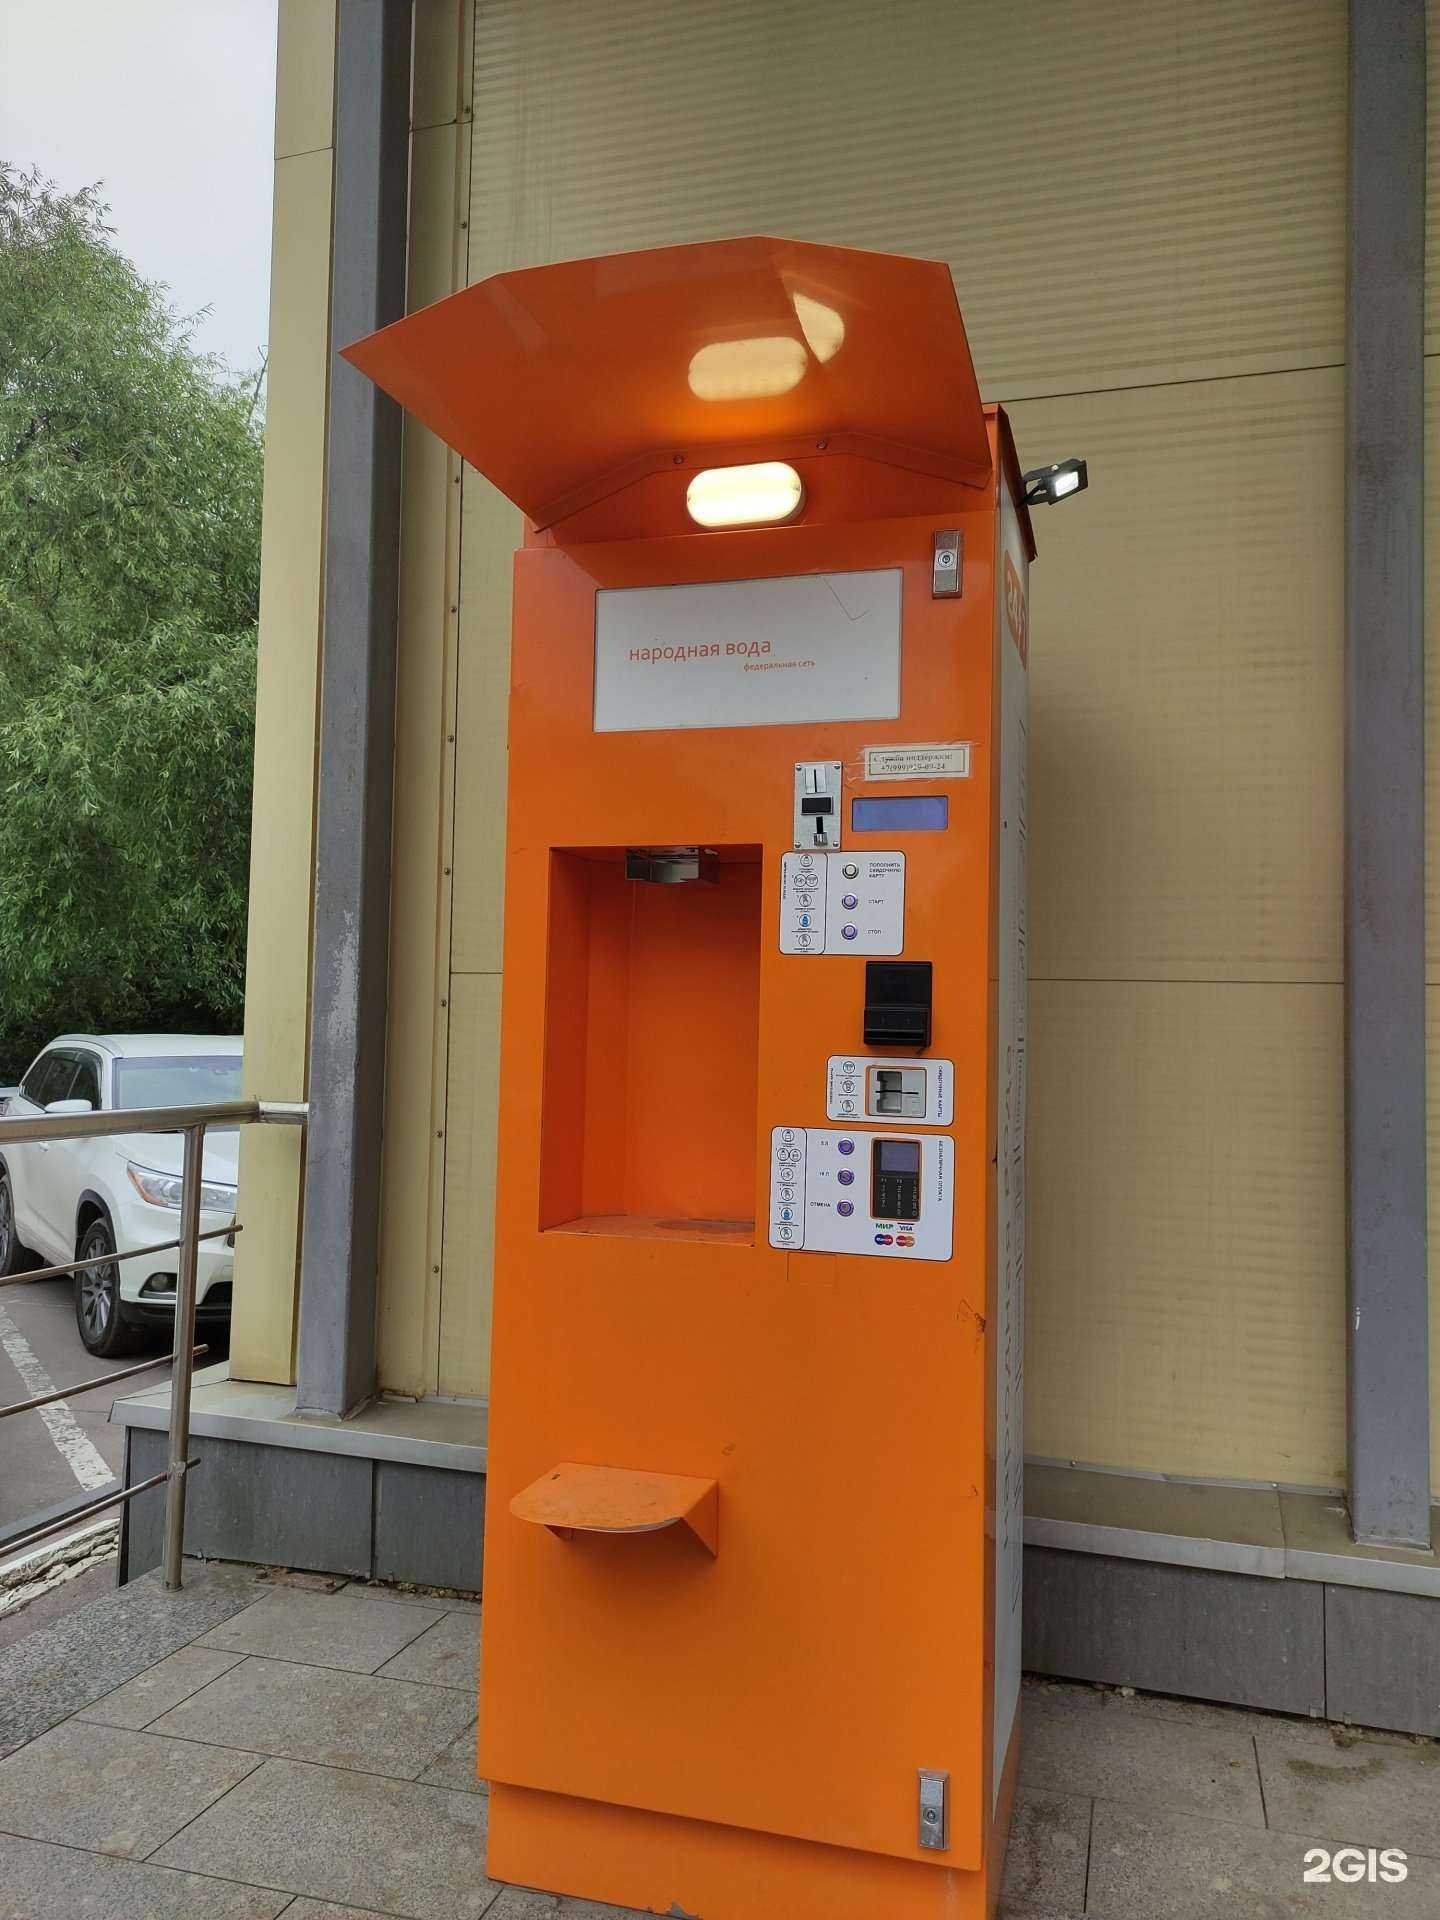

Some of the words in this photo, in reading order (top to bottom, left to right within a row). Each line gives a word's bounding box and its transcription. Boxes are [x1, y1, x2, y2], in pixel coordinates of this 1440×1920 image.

[629, 641, 720, 664] народная
[726, 638, 771, 658] вода
[743, 660, 797, 672] федеральная
[798, 659, 816, 669] сеть
[875, 1222, 894, 1230] МИР
